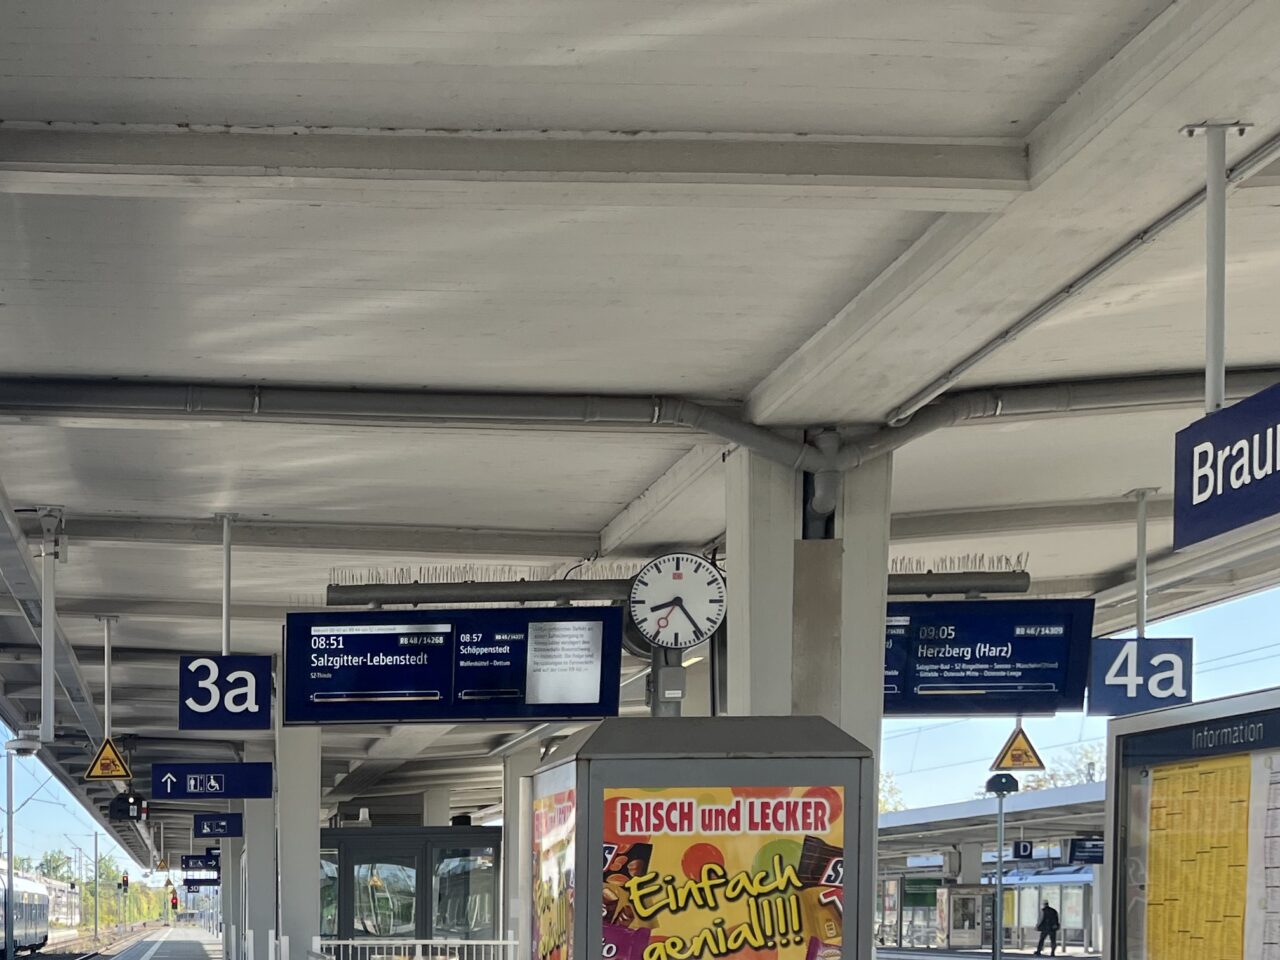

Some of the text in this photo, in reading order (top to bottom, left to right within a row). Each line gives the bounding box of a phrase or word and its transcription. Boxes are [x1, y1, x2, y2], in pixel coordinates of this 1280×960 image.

[1192, 423, 1280, 505] Brau
[460, 634, 482, 643] 08:57
[920, 626, 955, 639] 09:05
[311, 636, 345, 649] 08:51
[460, 645, 510, 655] Schöppenstedt
[917, 643, 1012, 660] Herzberg (Harz)
[311, 652, 428, 669] Salzgitter-Lebenstedt
[1104, 641, 1187, 698] 4a
[184, 658, 260, 714] 3a
[1191, 721, 1264, 750] Information
[620, 801, 827, 833] FRISCH und LECKER
[1020, 842, 1031, 856] D
[625, 853, 803, 918] Einfach
